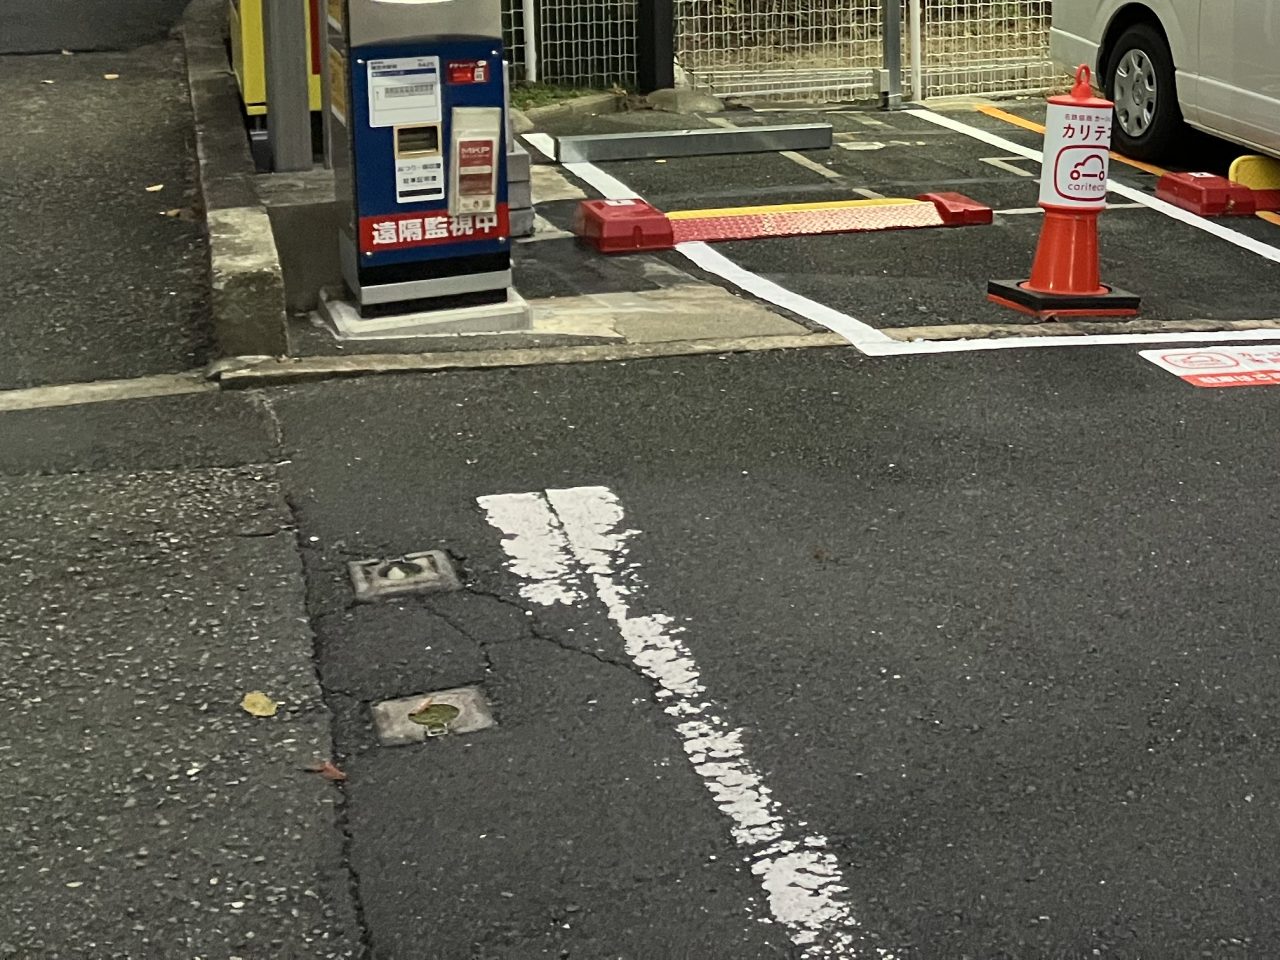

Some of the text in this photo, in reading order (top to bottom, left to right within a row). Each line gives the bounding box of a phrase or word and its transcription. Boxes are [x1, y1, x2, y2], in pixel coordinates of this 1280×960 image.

[461, 146, 490, 155] MKP
[372, 213, 498, 245] 遠隔監視中
